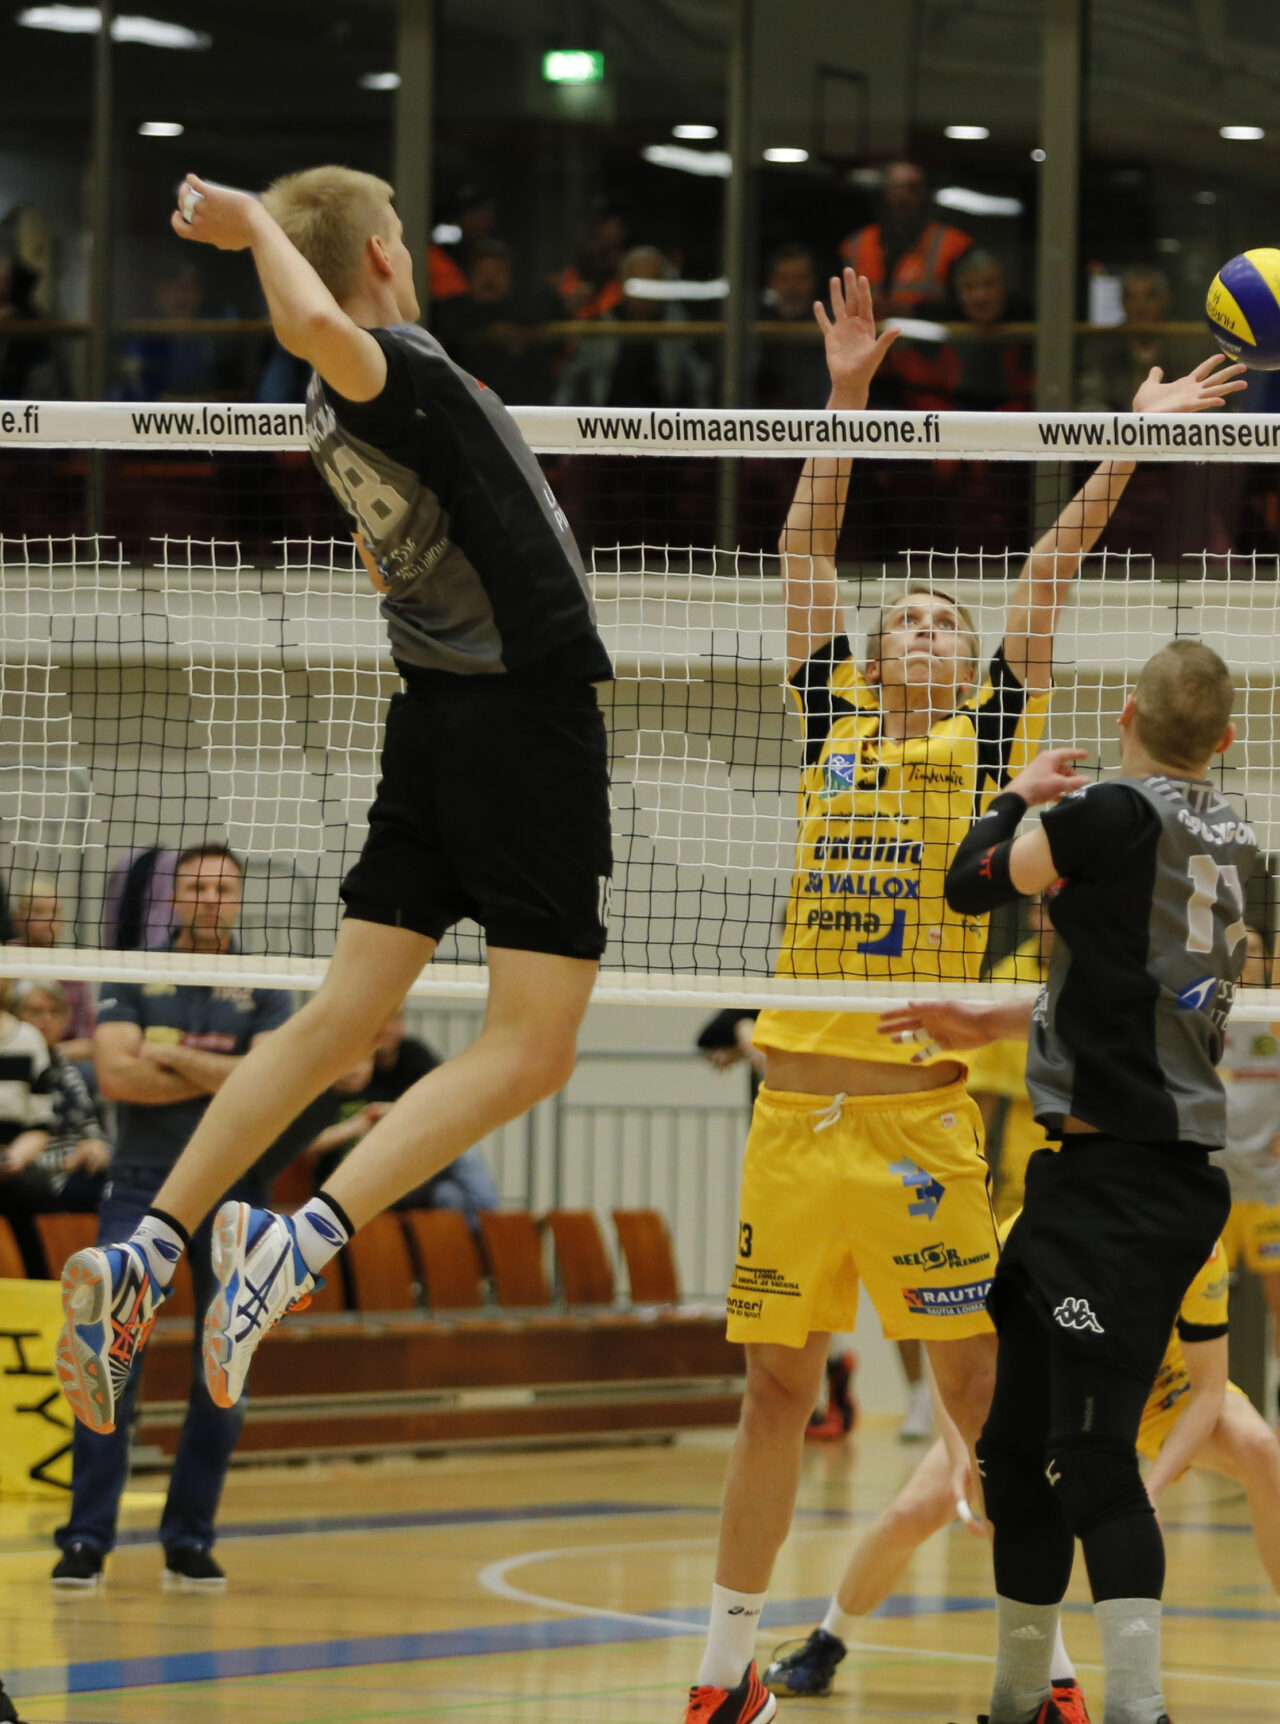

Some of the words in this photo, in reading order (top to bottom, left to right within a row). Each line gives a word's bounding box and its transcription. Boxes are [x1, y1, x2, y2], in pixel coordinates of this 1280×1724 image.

[132, 407, 305, 437] www.loimaan
[577, 411, 942, 443] www.loimaanseurahuone.fi
[828, 872, 921, 900] VALLOX
